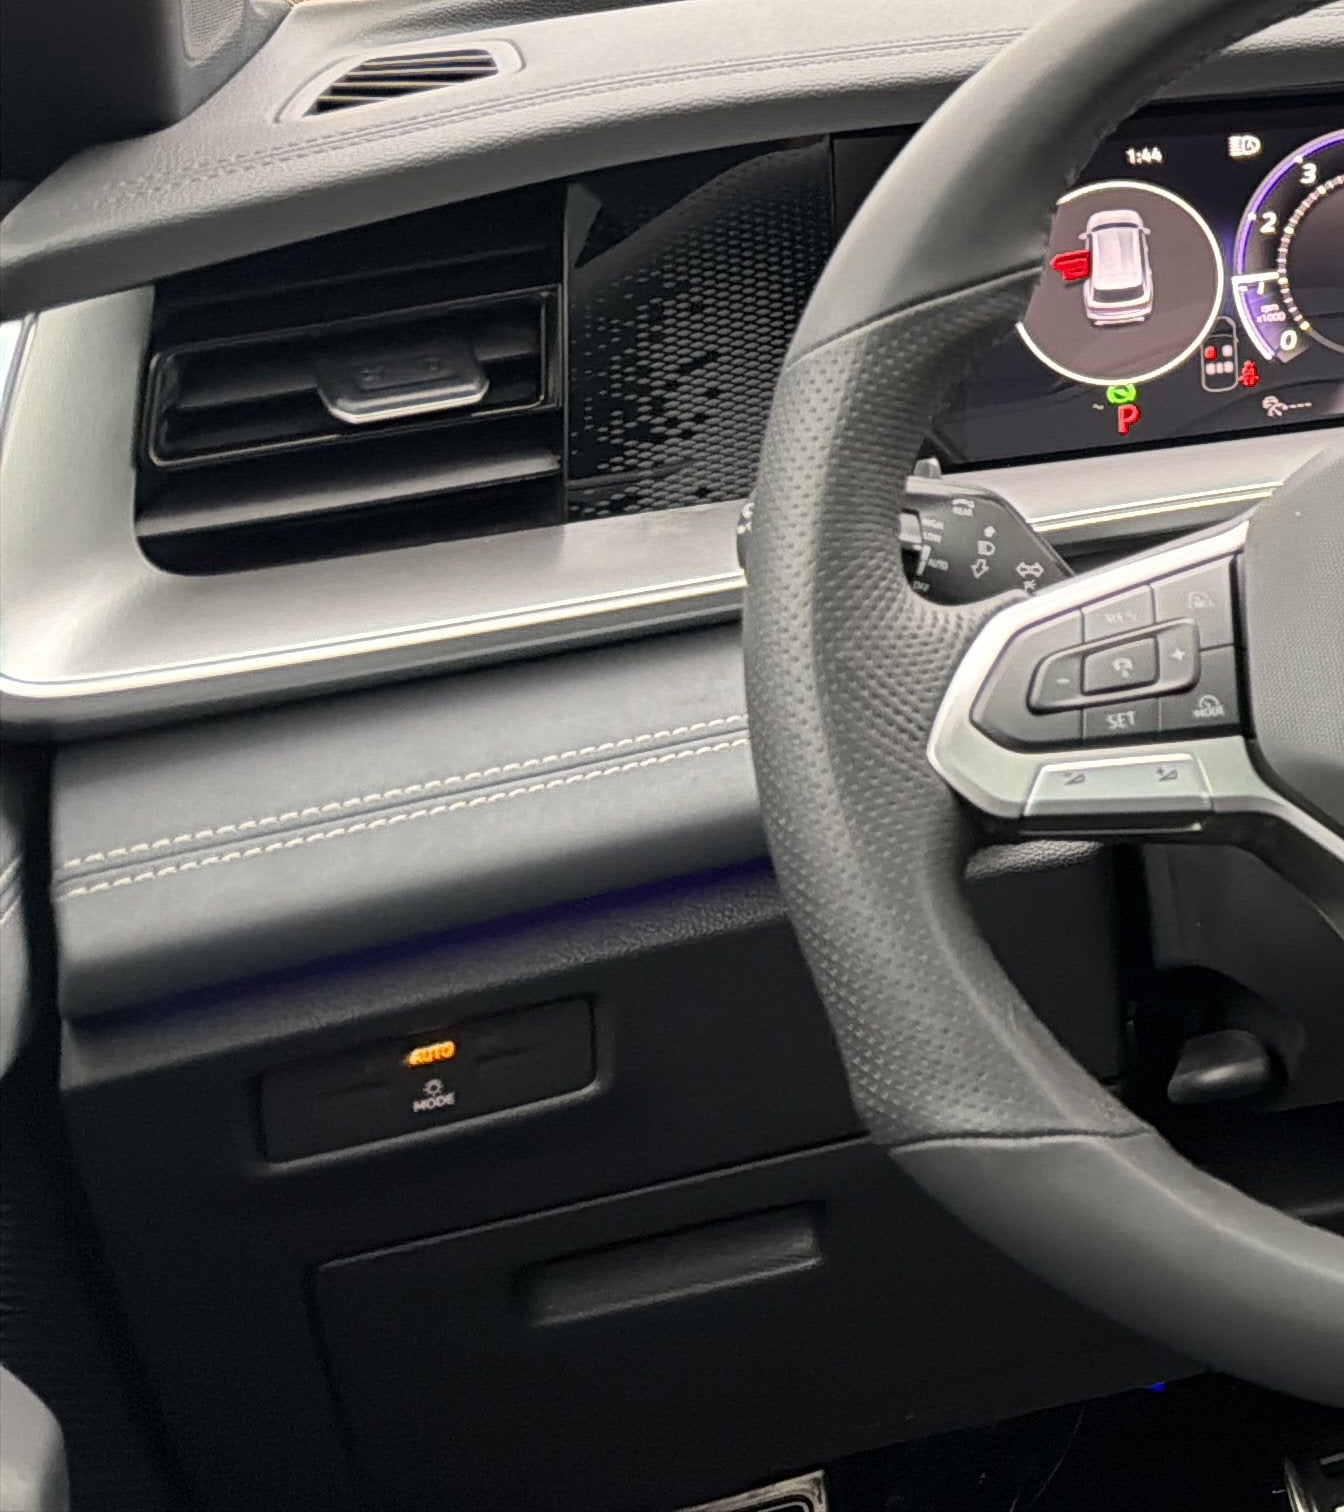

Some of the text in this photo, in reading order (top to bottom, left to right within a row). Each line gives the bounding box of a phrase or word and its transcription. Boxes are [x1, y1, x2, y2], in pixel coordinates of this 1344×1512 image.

[1126, 147, 1163, 164] 1:44
[1299, 164, 1317, 185] 3
[1260, 211, 1278, 234] 2
[1280, 330, 1298, 351] 0
[1117, 403, 1141, 435] P
[1106, 710, 1136, 730] SET
[407, 1040, 456, 1066] AUTO
[412, 1091, 456, 1113] MODE
